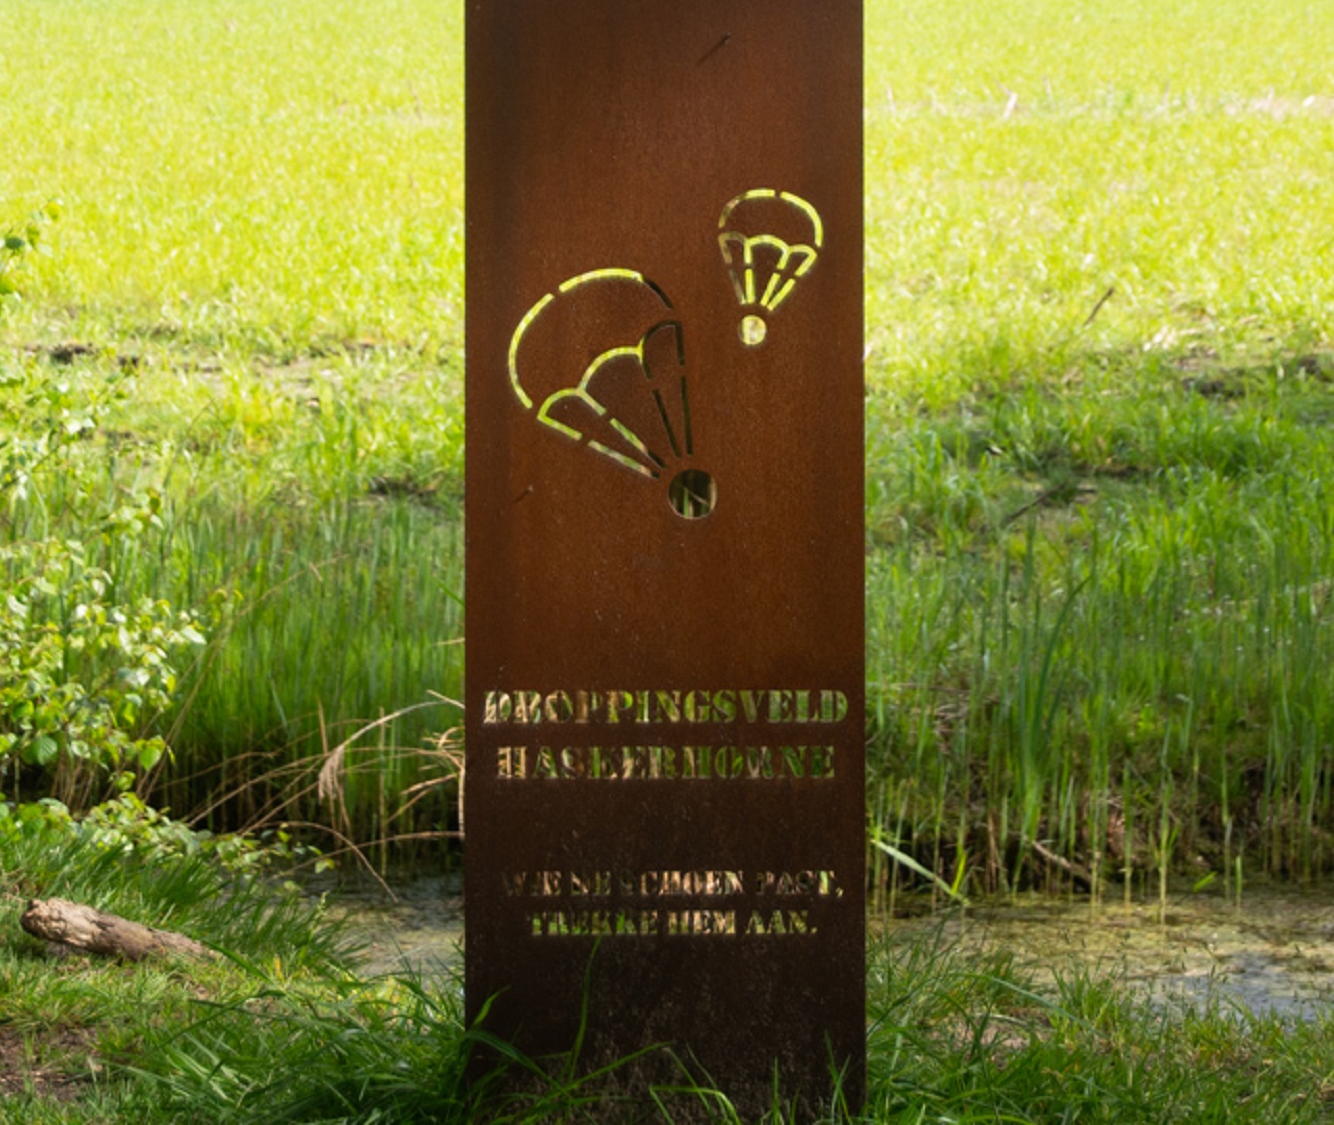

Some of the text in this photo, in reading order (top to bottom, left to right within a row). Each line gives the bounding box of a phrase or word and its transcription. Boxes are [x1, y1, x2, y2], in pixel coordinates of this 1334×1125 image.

[483, 689, 849, 724] DROPPINGSVELD
[497, 746, 836, 780] HASKERHORNE
[620, 870, 745, 896] SCHOEN
[668, 910, 737, 935] HEM
[745, 910, 818, 935] AAN.
